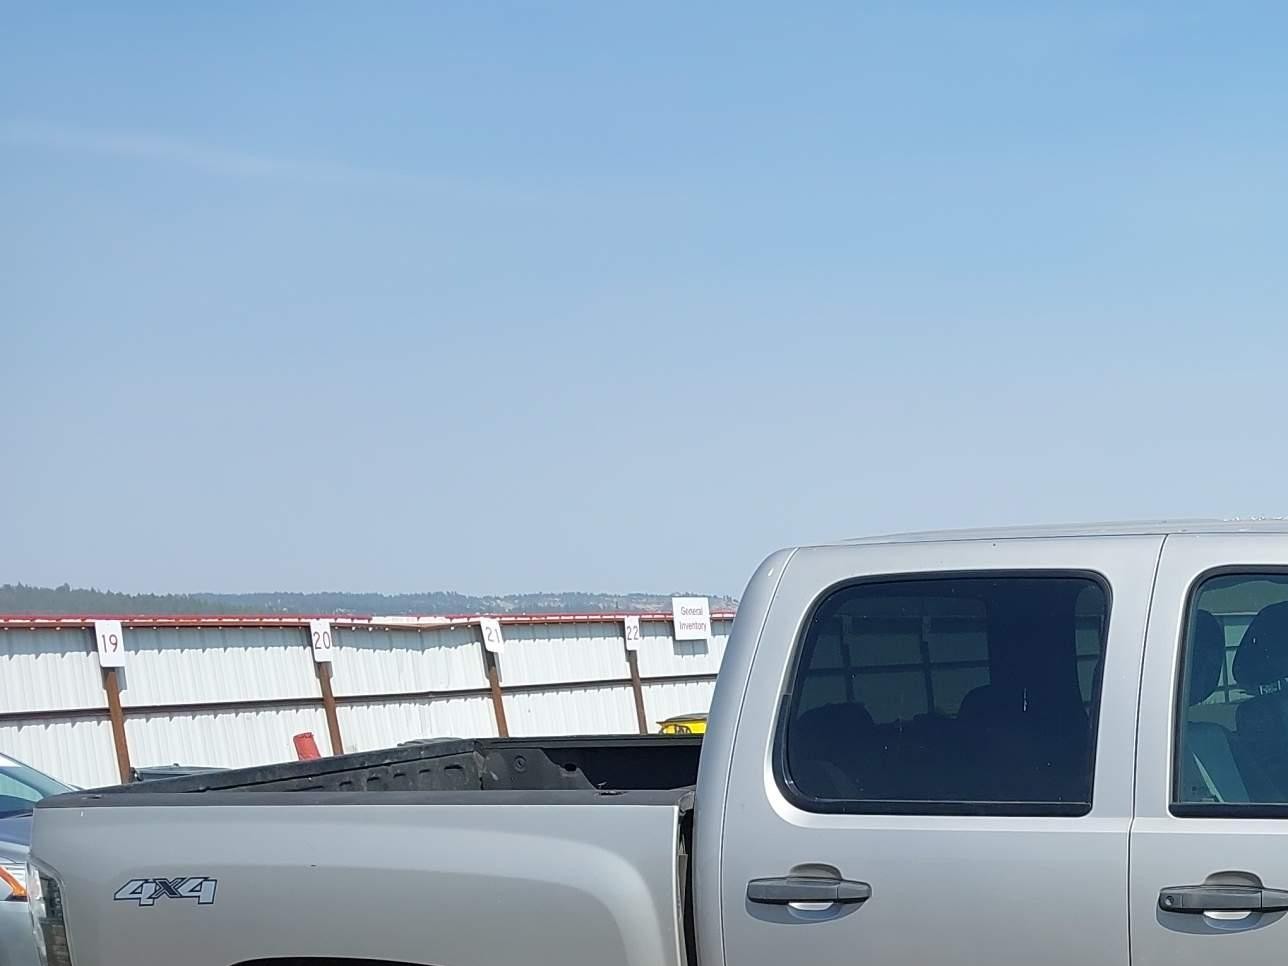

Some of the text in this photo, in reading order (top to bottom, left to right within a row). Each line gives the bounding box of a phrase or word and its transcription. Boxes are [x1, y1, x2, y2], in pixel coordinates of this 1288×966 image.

[680, 605, 704, 616] General
[485, 626, 501, 644] 21
[626, 625, 639, 641] 22
[679, 621, 707, 633] Inventory
[100, 633, 119, 654] 19
[312, 631, 331, 650] 20
